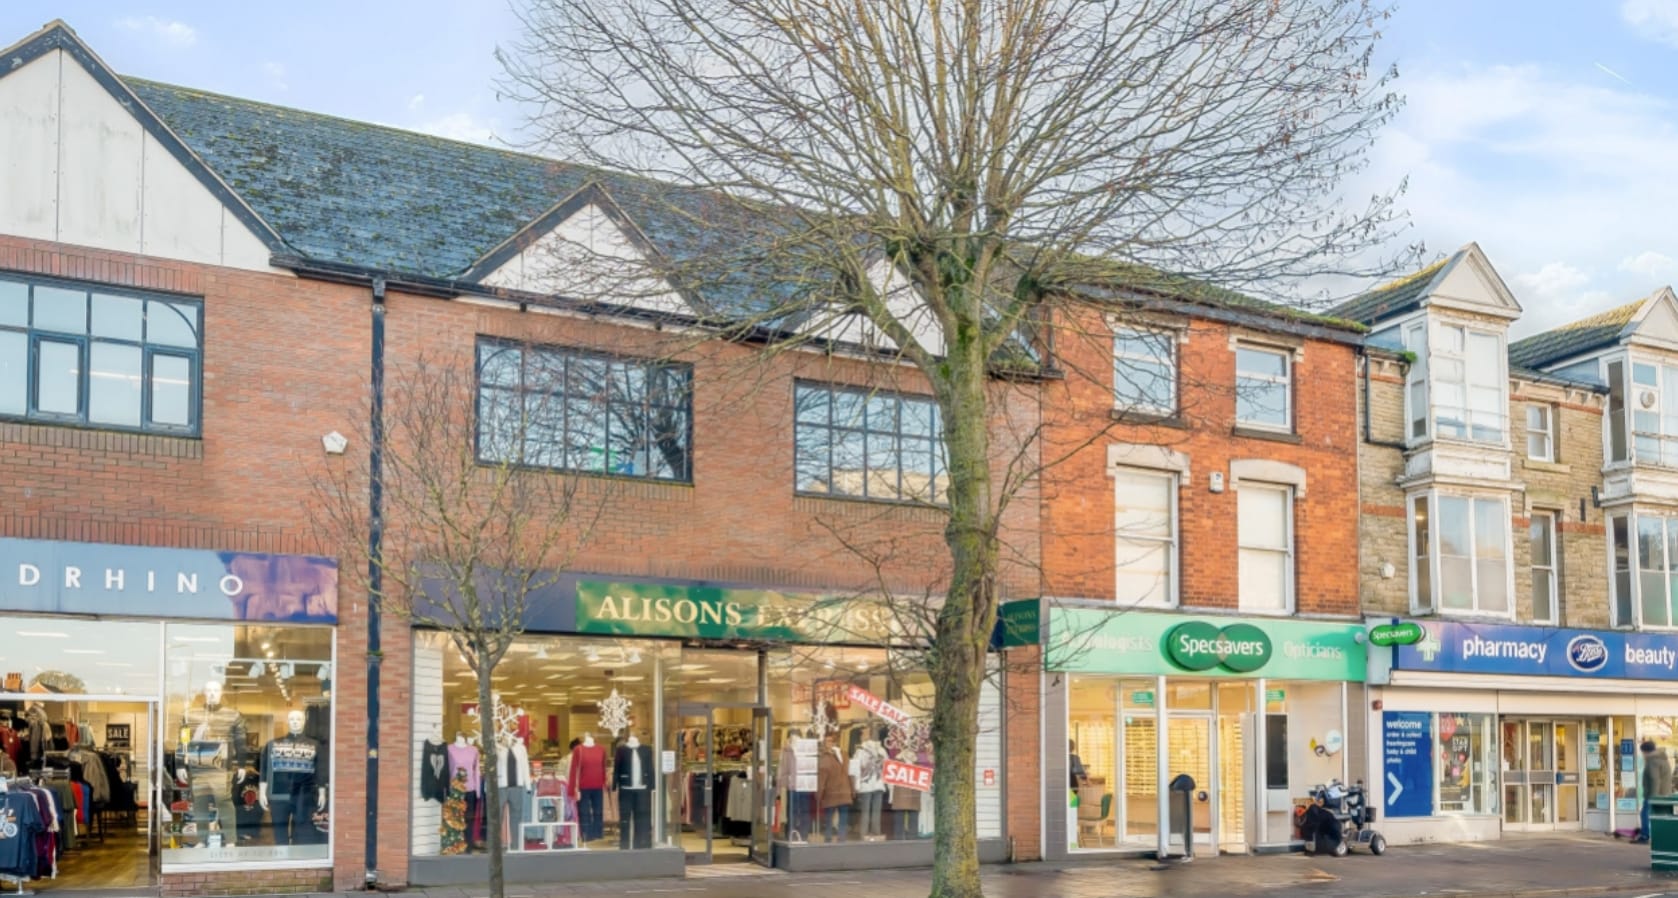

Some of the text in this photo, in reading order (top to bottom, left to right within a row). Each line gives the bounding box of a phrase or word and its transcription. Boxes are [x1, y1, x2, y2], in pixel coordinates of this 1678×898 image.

[19, 564, 243, 596] DRHINO
[595, 595, 888, 632] ALISONS EXRSS
[1373, 629, 1413, 640] Specsavers
[1180, 635, 1263, 657] Specsavers
[1284, 640, 1343, 661] Opticians
[1463, 636, 1547, 663] pharmacy
[1625, 644, 1676, 669] beauty
[850, 688, 878, 709] SALE
[107, 727, 129, 739] SALE
[1386, 720, 1422, 729] welcome
[885, 765, 930, 787] SALE
